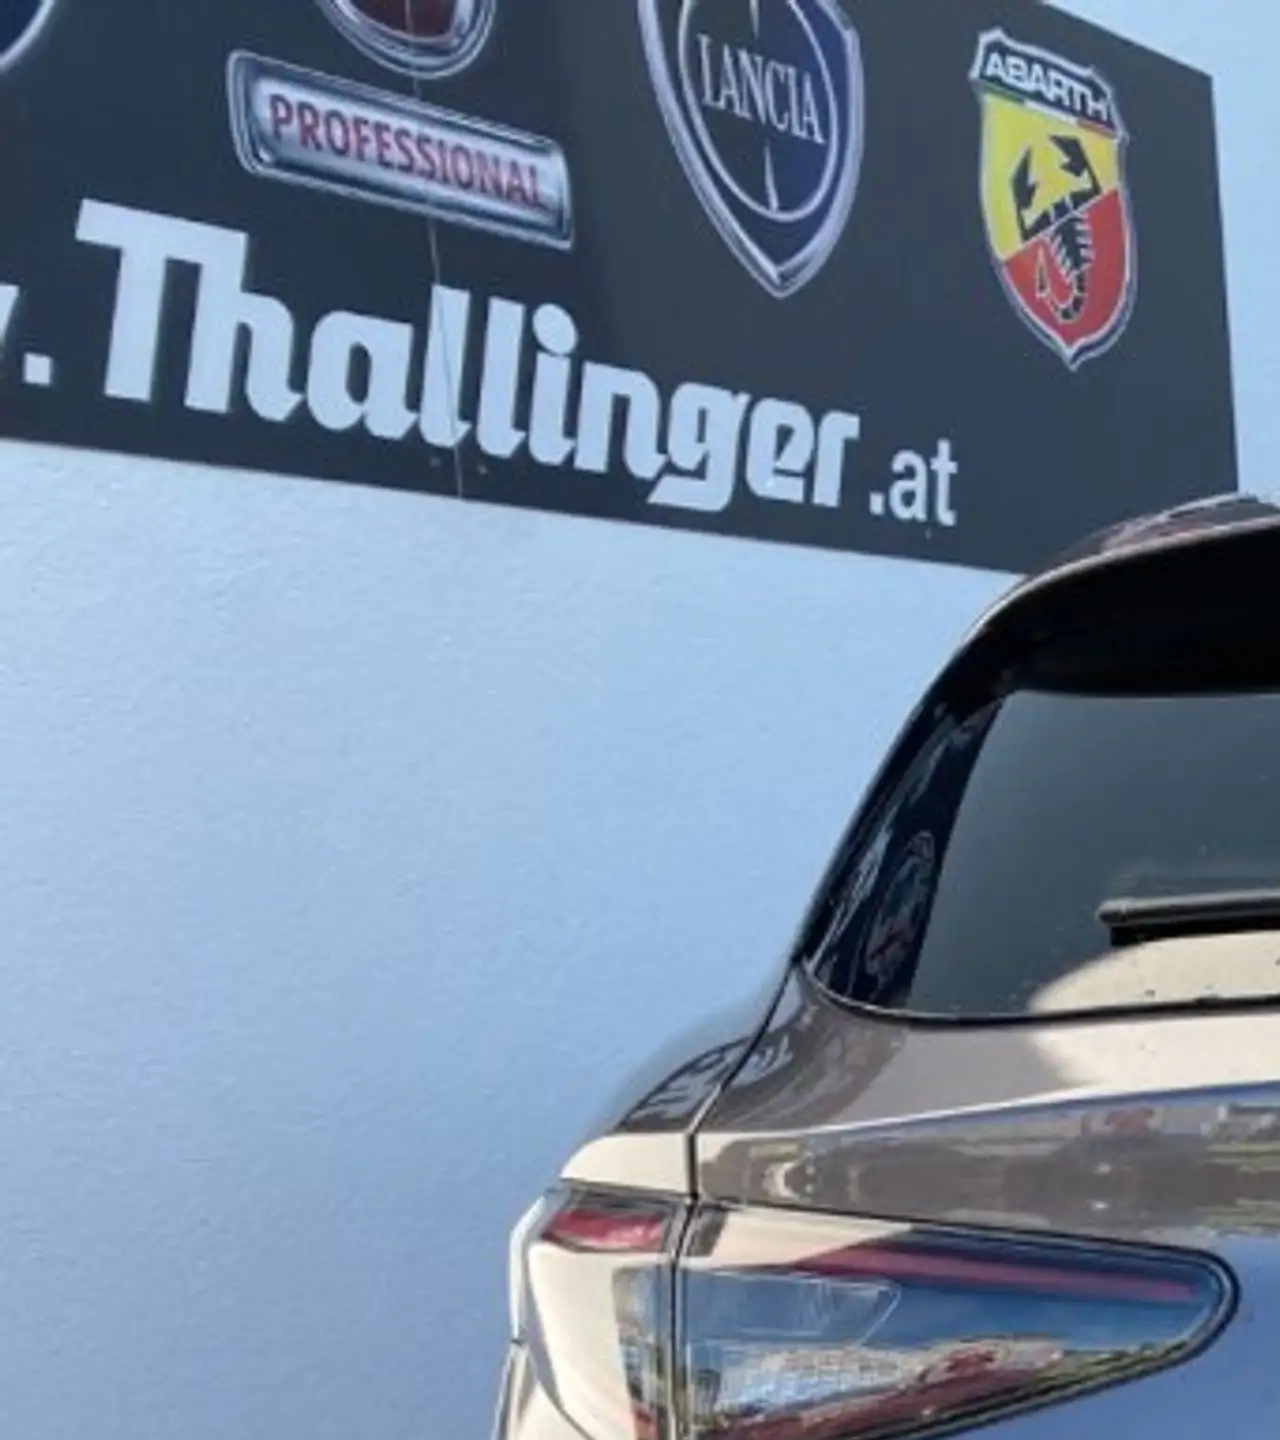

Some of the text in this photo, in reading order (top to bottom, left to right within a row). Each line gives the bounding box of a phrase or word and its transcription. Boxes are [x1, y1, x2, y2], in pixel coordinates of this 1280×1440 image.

[697, 33, 825, 146] LANCIA
[985, 50, 1115, 122] ABARTH
[268, 94, 548, 204] PROFESSIONAL
